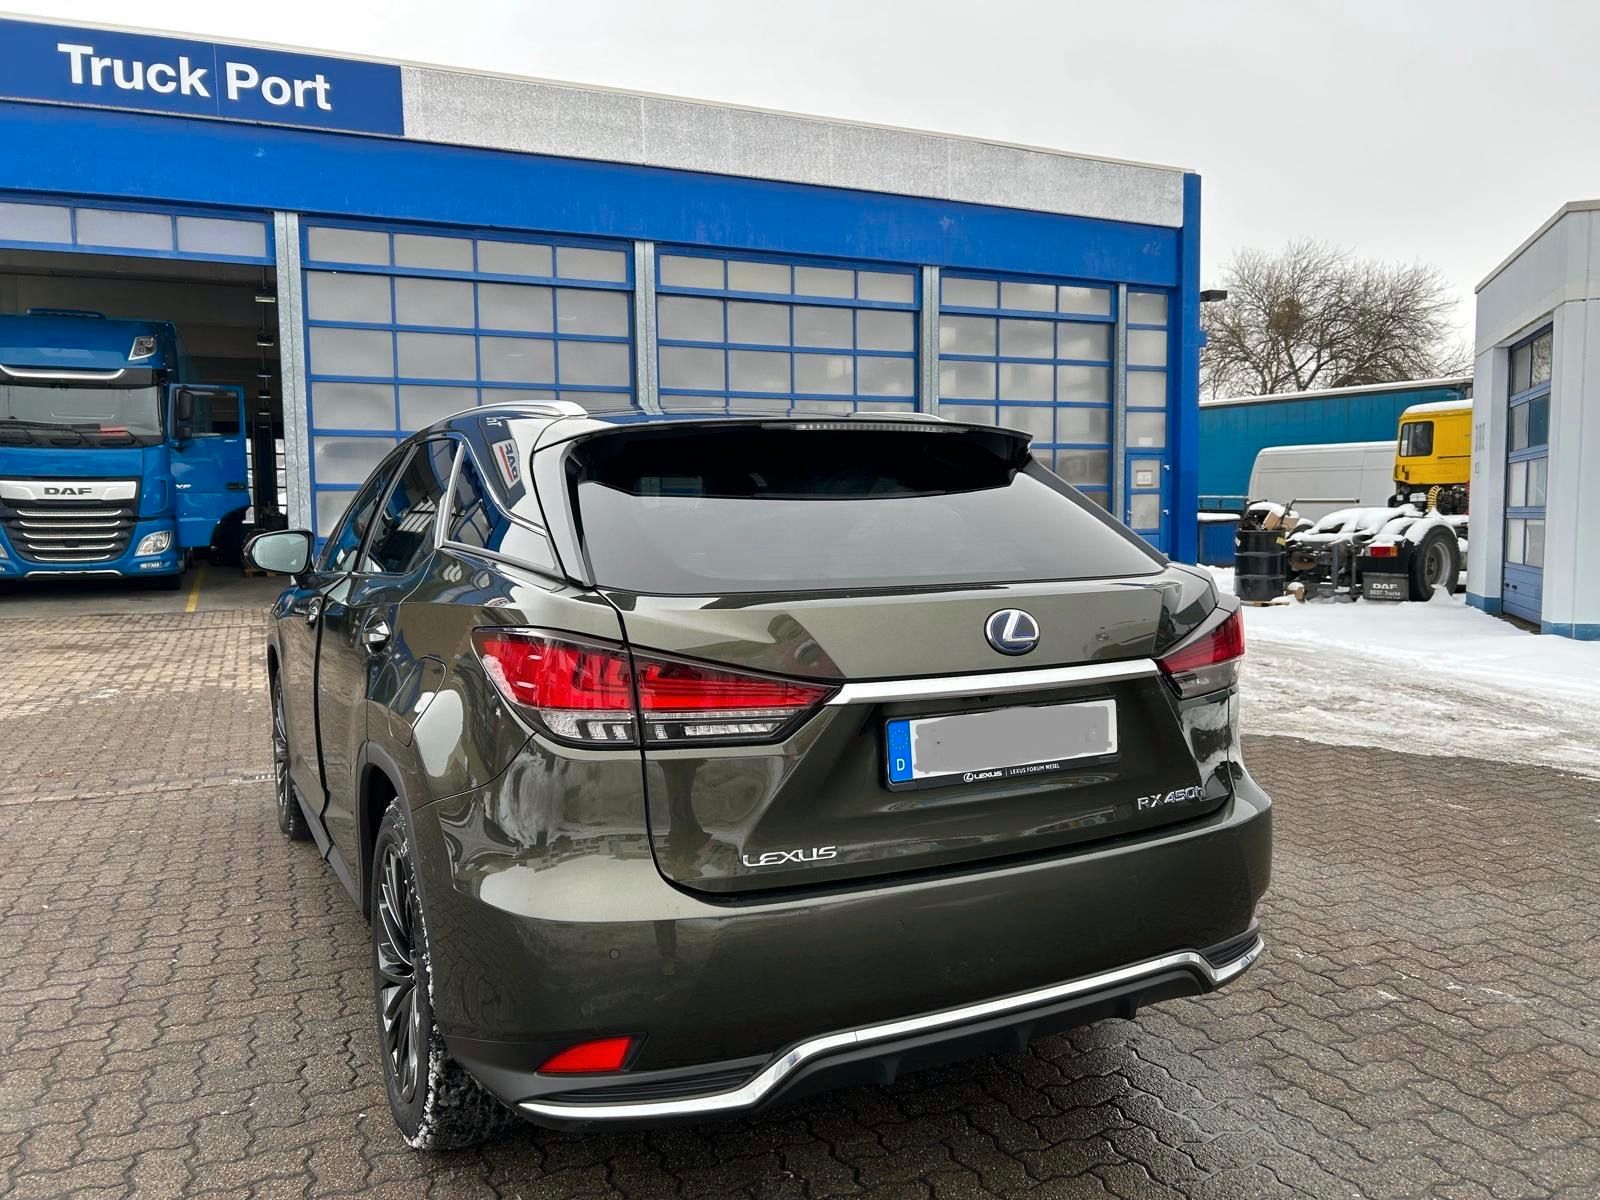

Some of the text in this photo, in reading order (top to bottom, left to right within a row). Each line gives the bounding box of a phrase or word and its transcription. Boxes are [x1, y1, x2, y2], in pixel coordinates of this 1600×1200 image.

[57, 43, 332, 110] Truck Port
[43, 487, 92, 496] DAF
[896, 758, 906, 771] D
[1009, 767, 1026, 775] LEXUS
[1026, 765, 1045, 773] FORUM
[974, 770, 1003, 780] LEXUS
[1137, 785, 1203, 811] RX 450h
[742, 845, 837, 867] LEXUS
